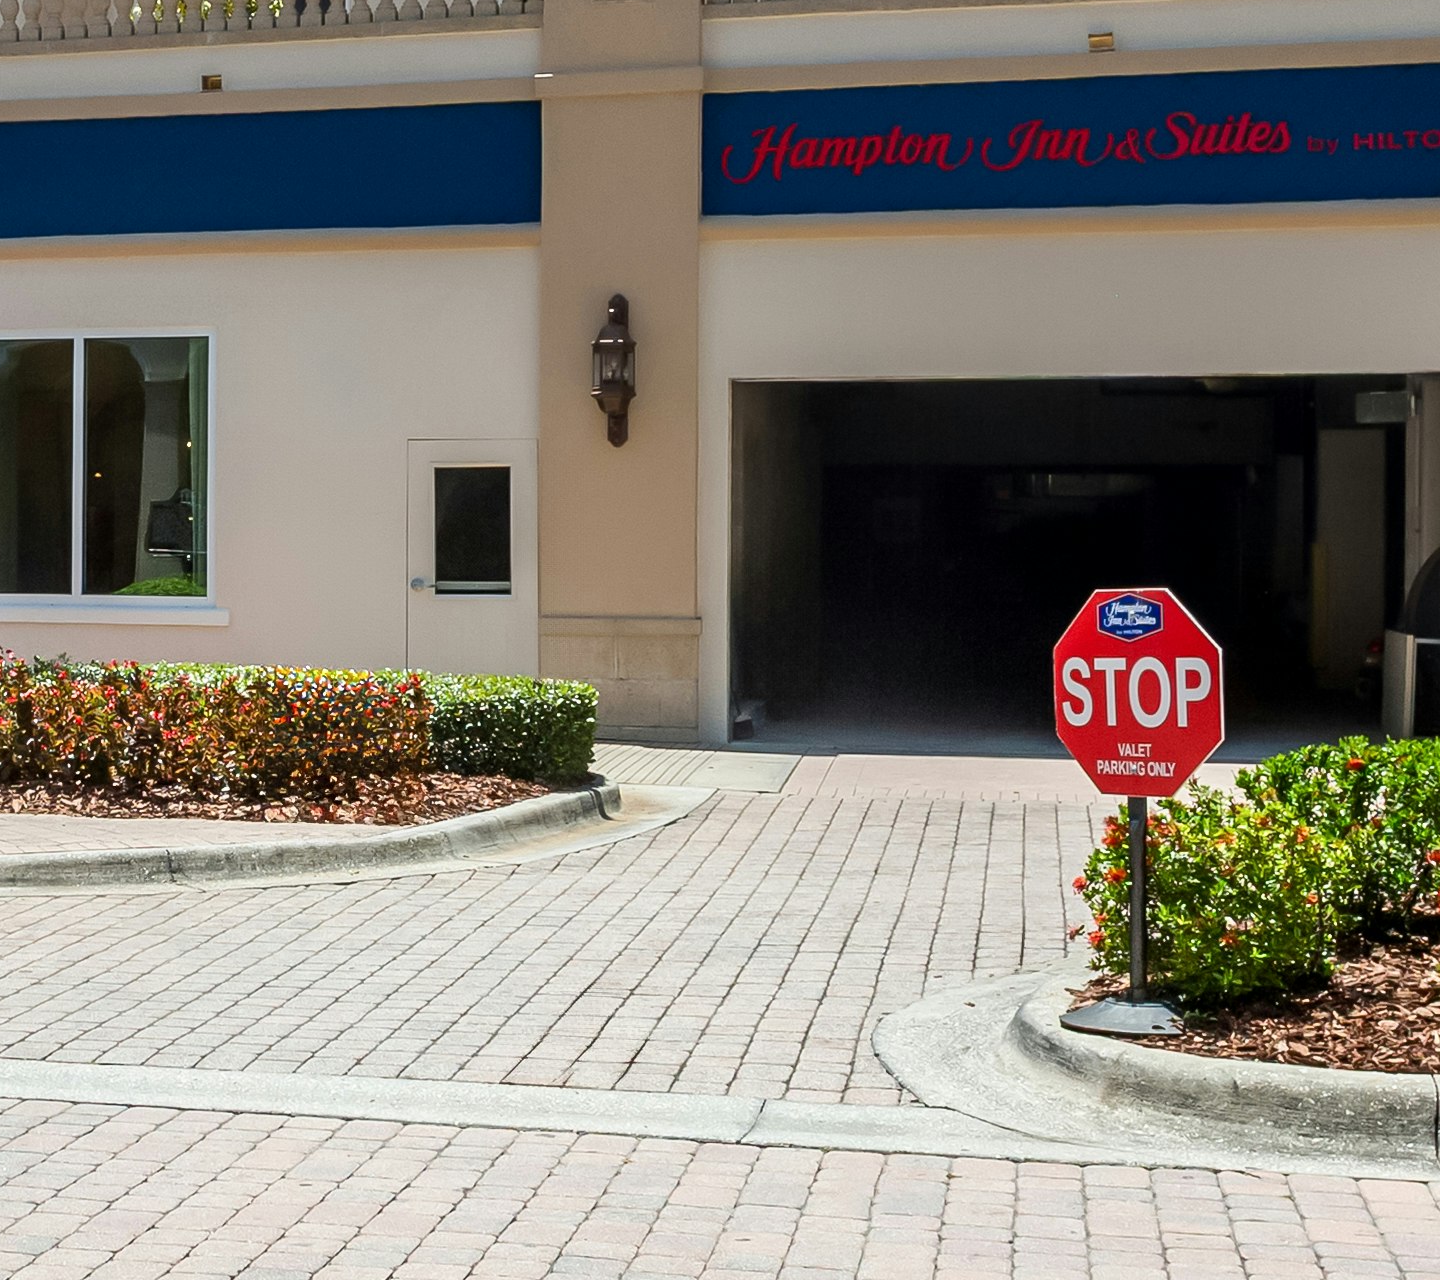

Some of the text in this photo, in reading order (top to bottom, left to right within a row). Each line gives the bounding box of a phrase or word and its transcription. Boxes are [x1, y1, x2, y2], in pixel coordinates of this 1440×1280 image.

[721, 122, 975, 184] Hampton
[980, 119, 1115, 173] Inn
[1114, 128, 1146, 164] &
[1145, 111, 1292, 161] Suites
[1306, 135, 1339, 155] by
[1062, 656, 1212, 729] STOP
[1096, 759, 1176, 777] PARKING ONLY
[1117, 743, 1152, 758] VALET
